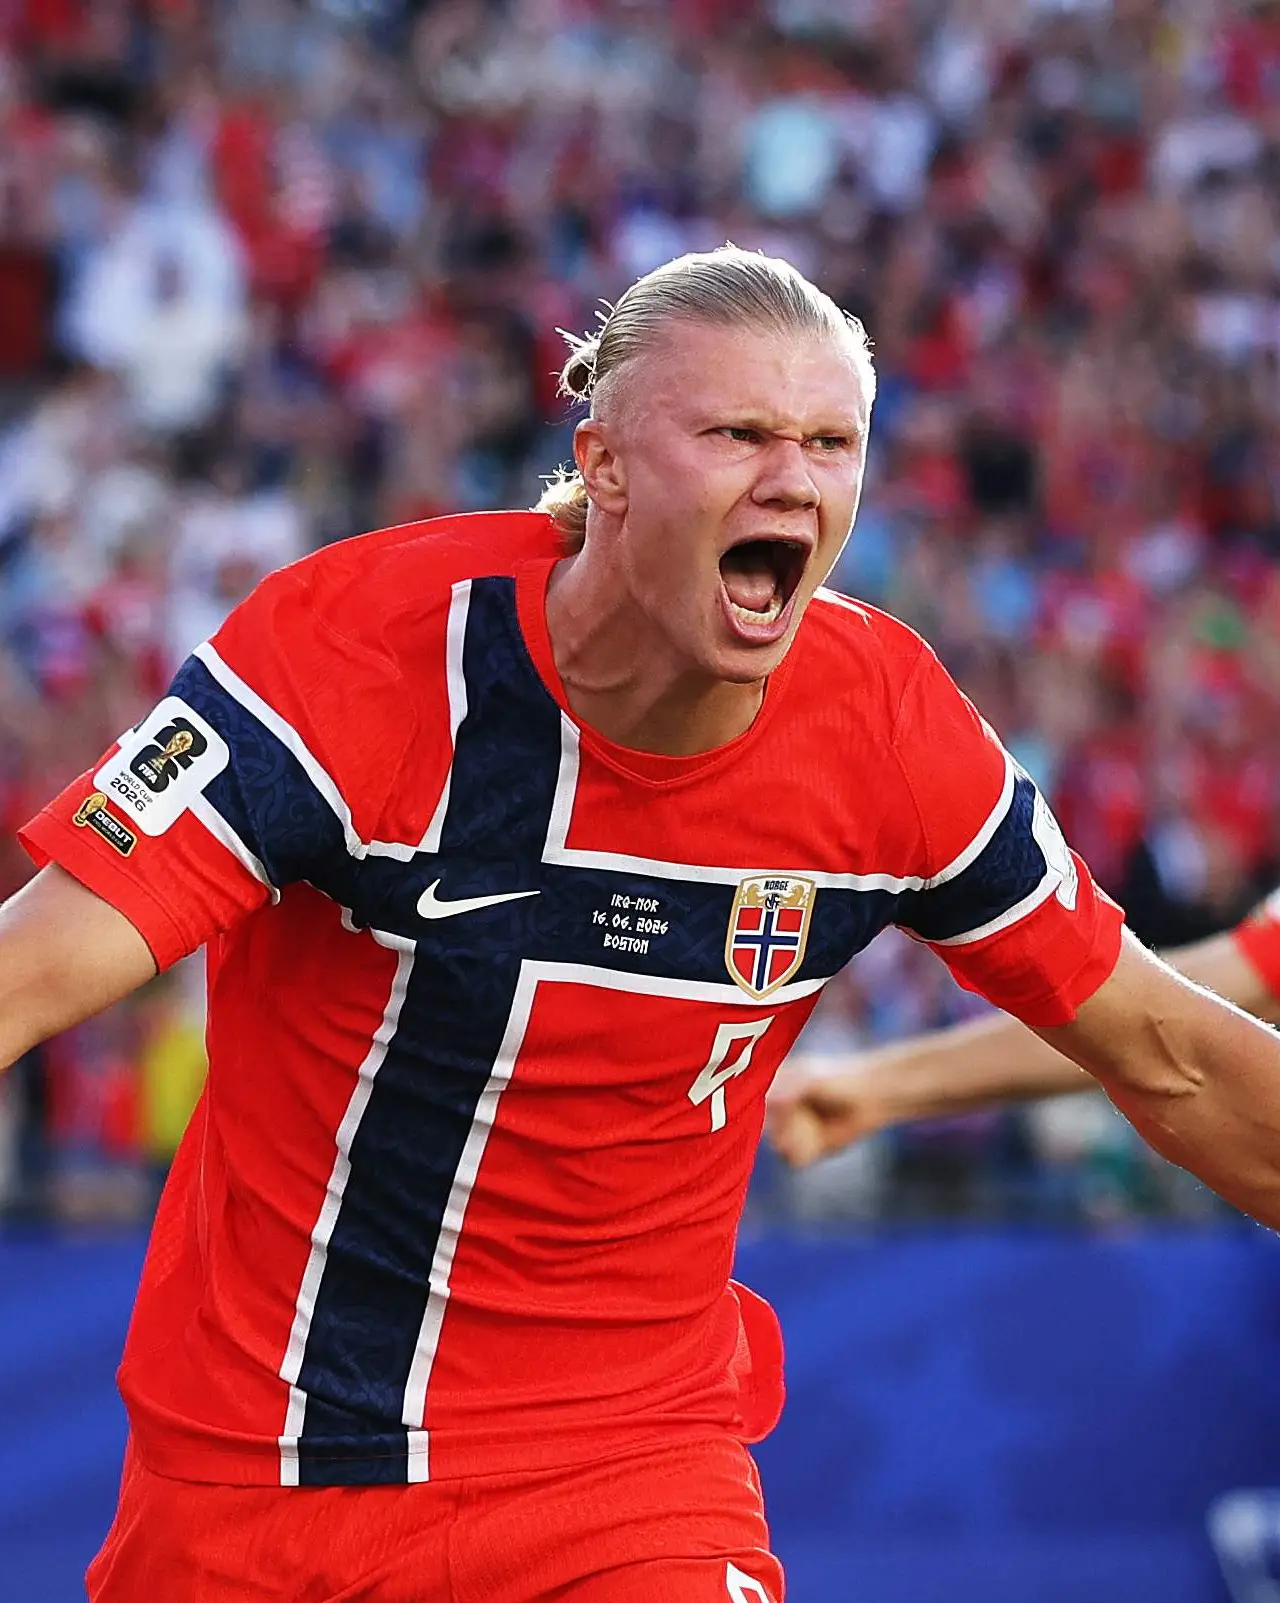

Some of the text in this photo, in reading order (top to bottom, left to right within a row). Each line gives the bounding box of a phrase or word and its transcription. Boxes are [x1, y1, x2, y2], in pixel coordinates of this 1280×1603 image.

[120, 770, 153, 803] WORLD CUP
[138, 763, 158, 784] FIFA
[110, 778, 146, 812] 2026
[95, 810, 132, 843] DEBUT
[763, 880, 790, 892] NORGE
[610, 893, 660, 913] IRQ-NOR
[603, 932, 650, 954] BOSTON
[687, 1014, 776, 1133] 9
